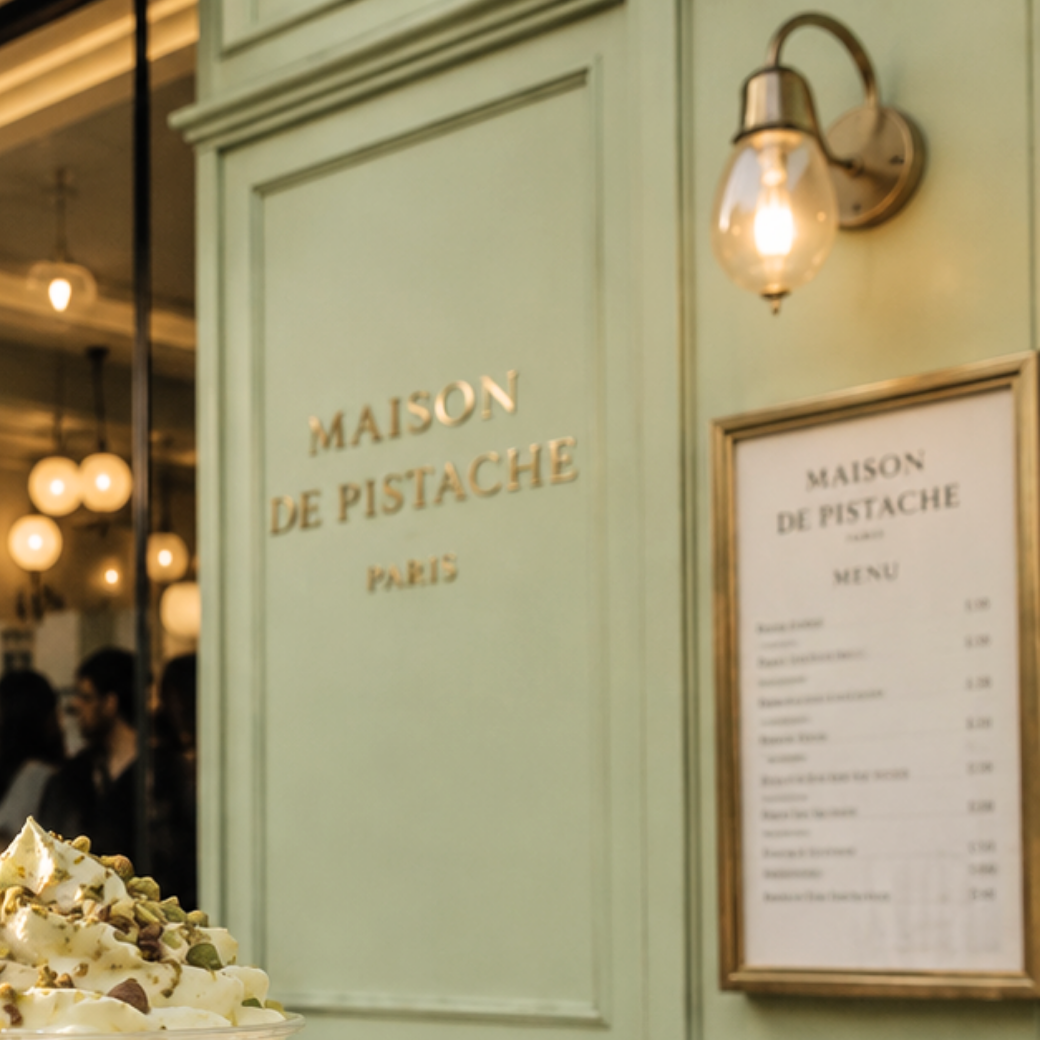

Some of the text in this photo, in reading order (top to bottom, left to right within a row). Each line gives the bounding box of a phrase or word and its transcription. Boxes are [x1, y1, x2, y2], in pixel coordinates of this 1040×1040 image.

[308, 369, 519, 458] MAISON
[270, 436, 578, 537] DE PISTACHE
[806, 448, 926, 492] MAISON
[776, 482, 961, 536] DE PISTACHE
[366, 553, 458, 594] PARIS
[833, 562, 899, 588] MENU
